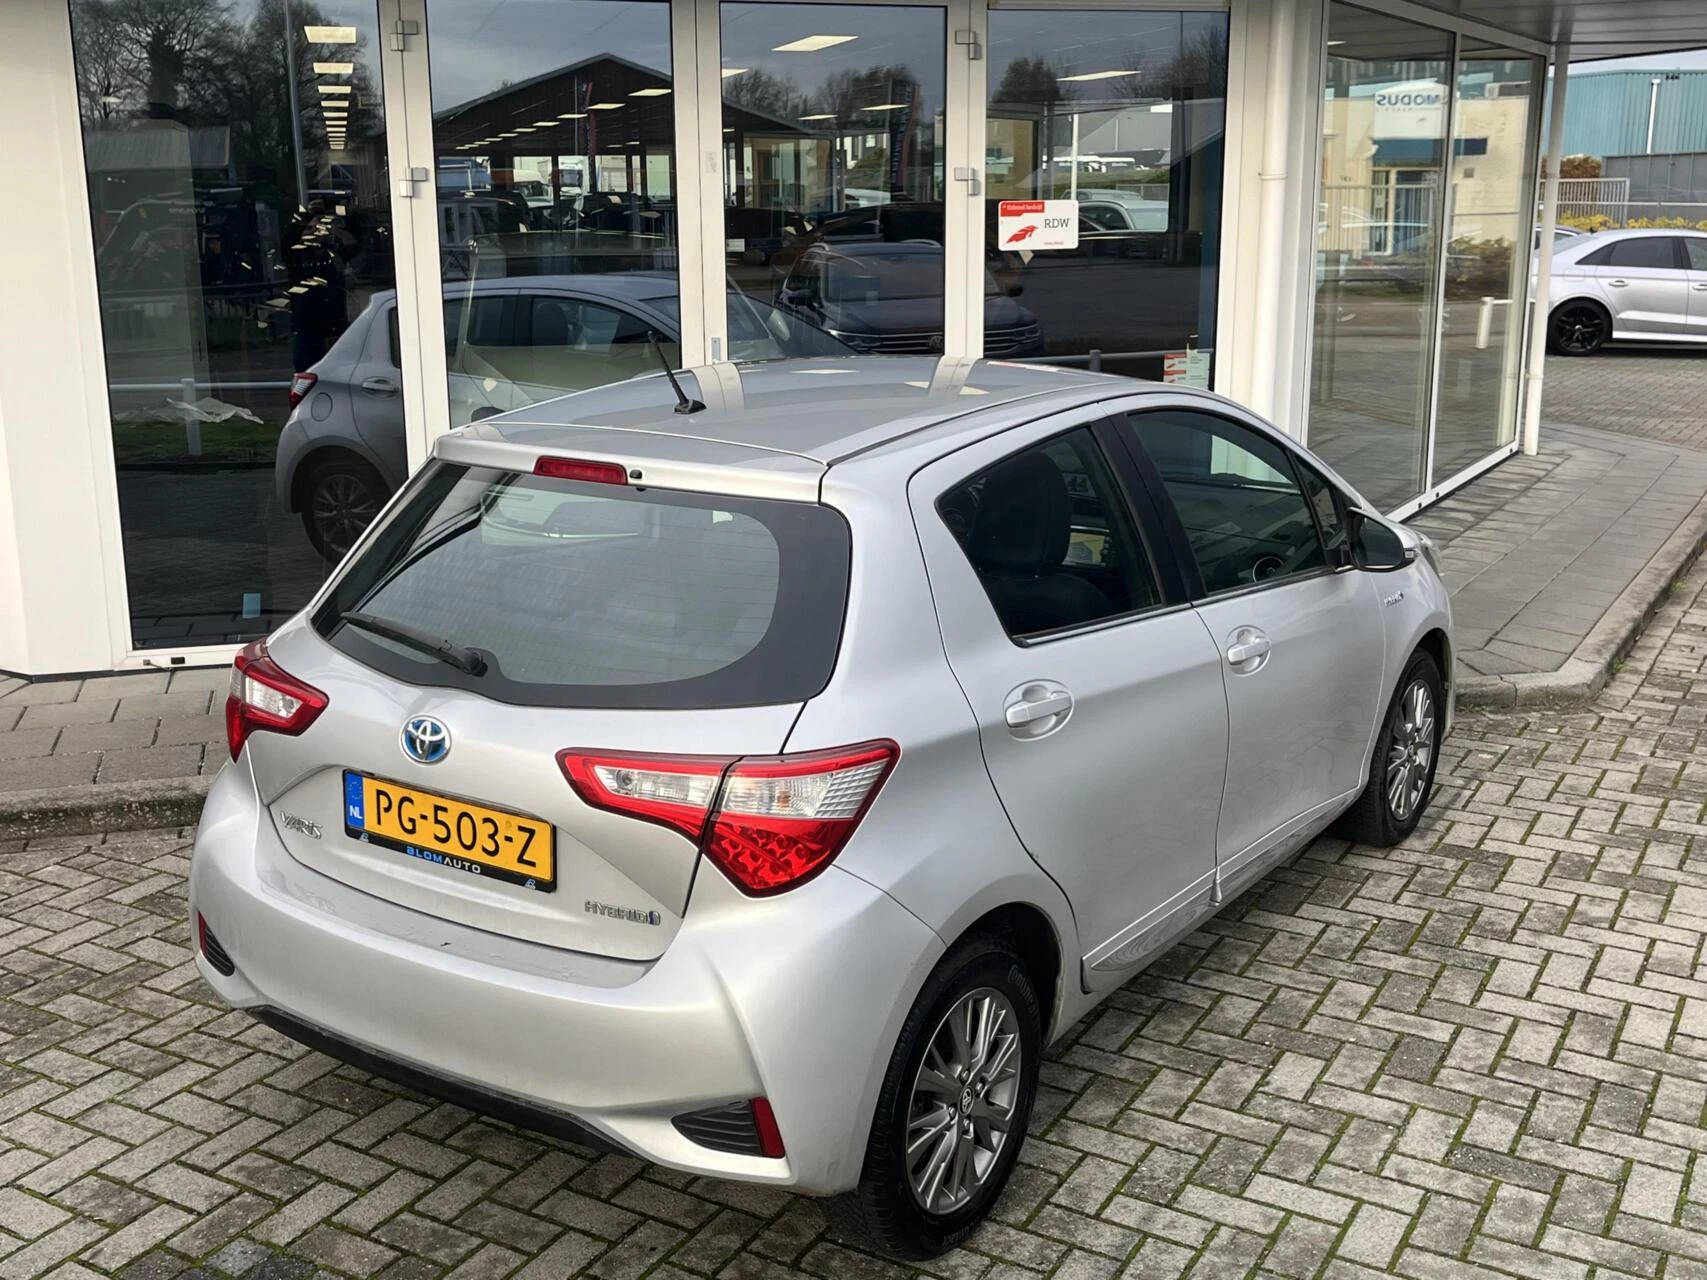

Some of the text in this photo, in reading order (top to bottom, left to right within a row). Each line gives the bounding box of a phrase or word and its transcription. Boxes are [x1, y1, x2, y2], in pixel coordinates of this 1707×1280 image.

[1043, 218, 1070, 229] RDW
[349, 805, 363, 819] NL
[375, 788, 537, 868] PG-503-Z
[406, 846, 482, 874] BLOMAUTO
[584, 900, 648, 924] HYBRID
